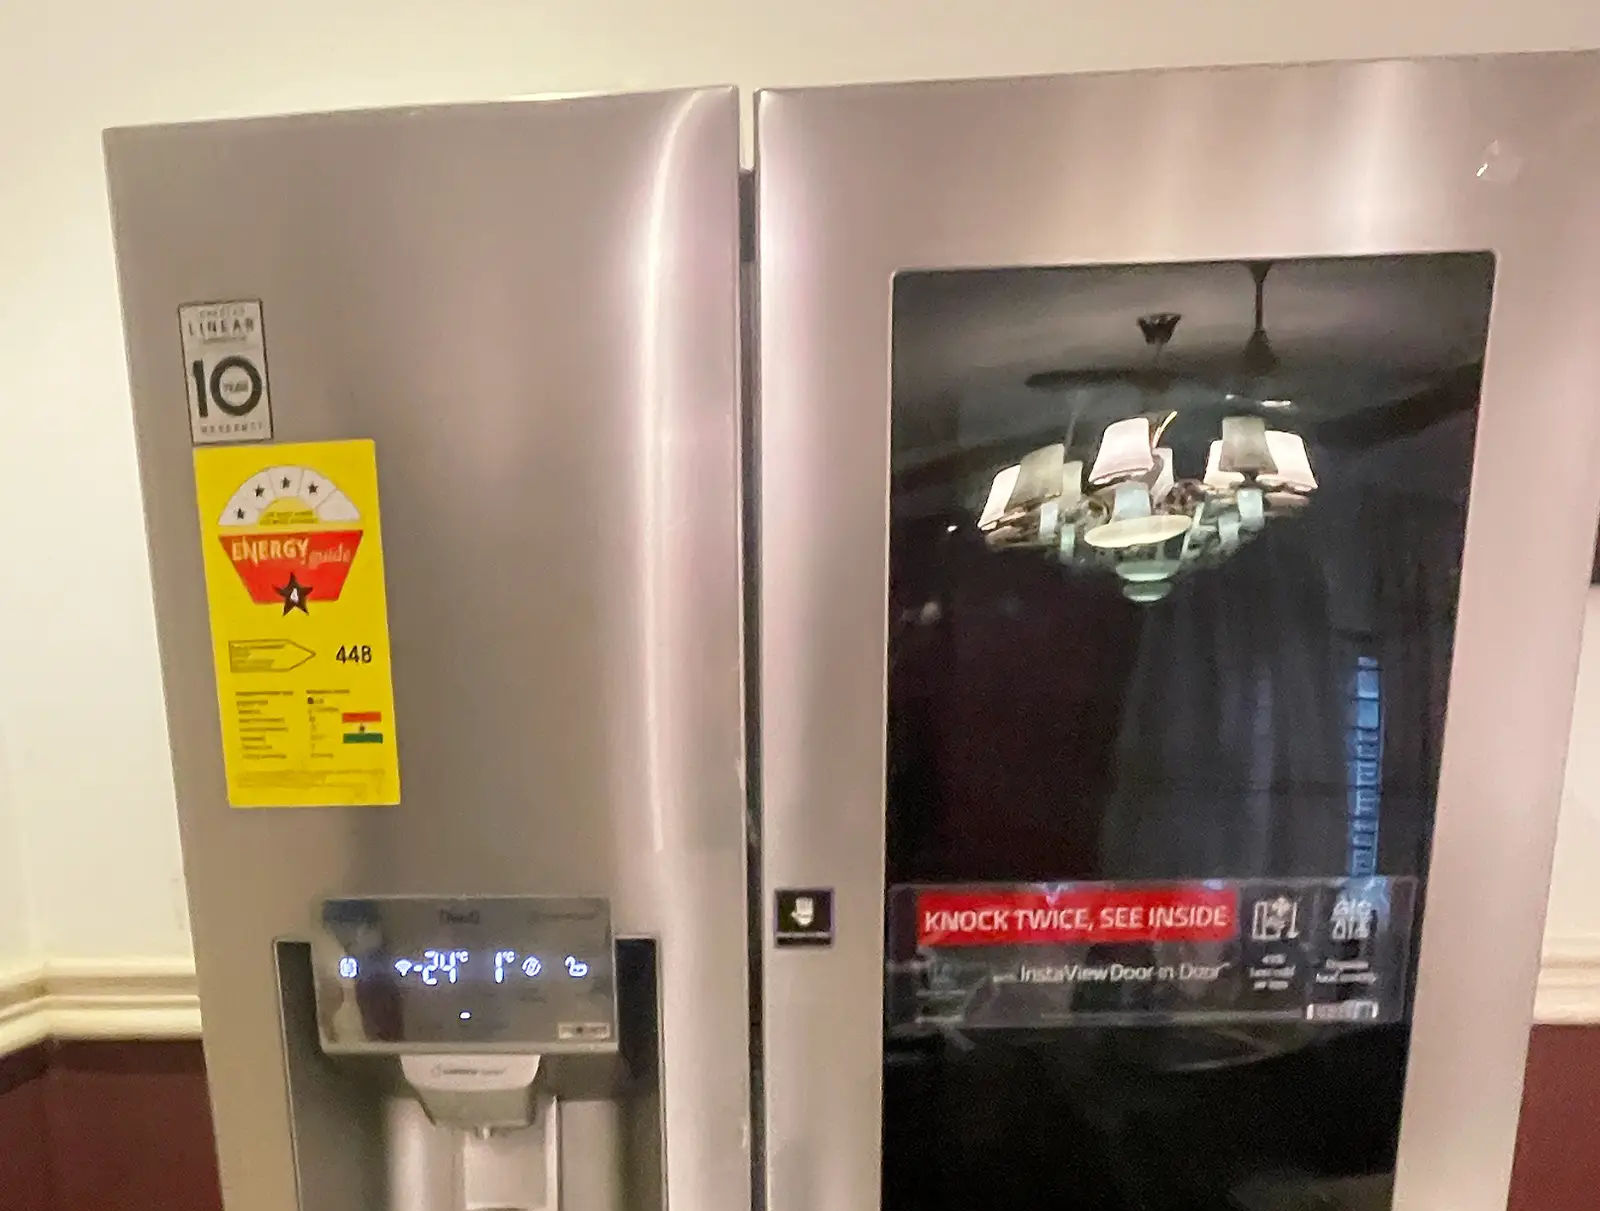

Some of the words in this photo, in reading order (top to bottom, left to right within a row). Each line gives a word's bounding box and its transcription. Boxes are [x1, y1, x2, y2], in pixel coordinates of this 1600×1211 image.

[192, 355, 262, 416] 10
[231, 536, 309, 565] ENERGY
[290, 587, 299, 603] 4
[335, 645, 373, 663] 448
[924, 909, 1009, 932] KNOCK
[1013, 908, 1094, 931] TWICE,
[1100, 906, 1144, 929] SEE
[1148, 904, 1228, 928] INSIDE
